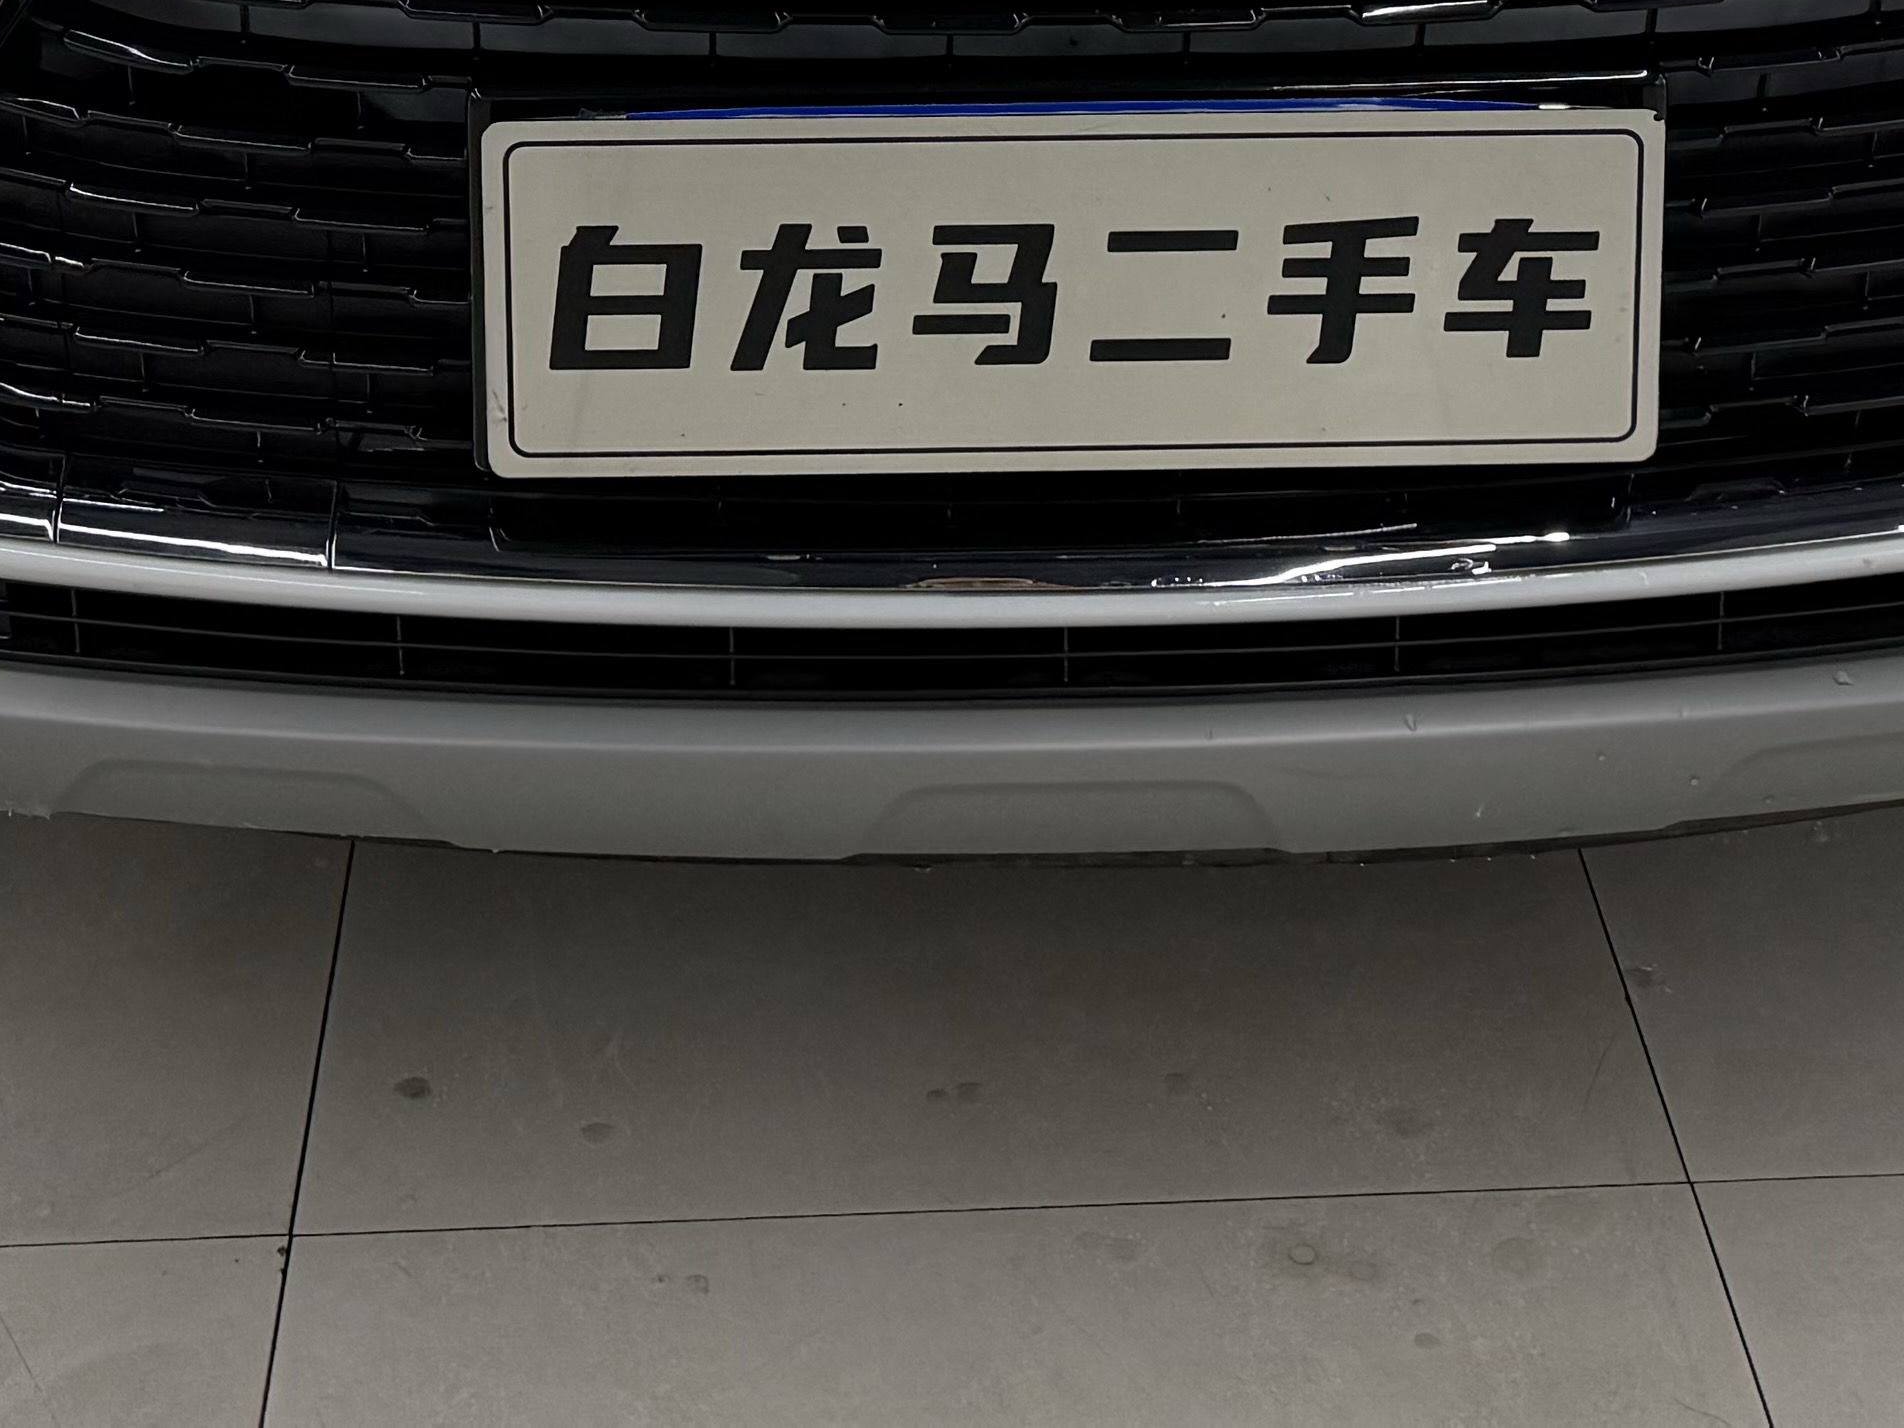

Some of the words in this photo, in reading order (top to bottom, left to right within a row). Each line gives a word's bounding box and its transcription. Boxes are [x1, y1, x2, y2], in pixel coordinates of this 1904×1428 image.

[548, 214, 1602, 373] 白龙马二手车
